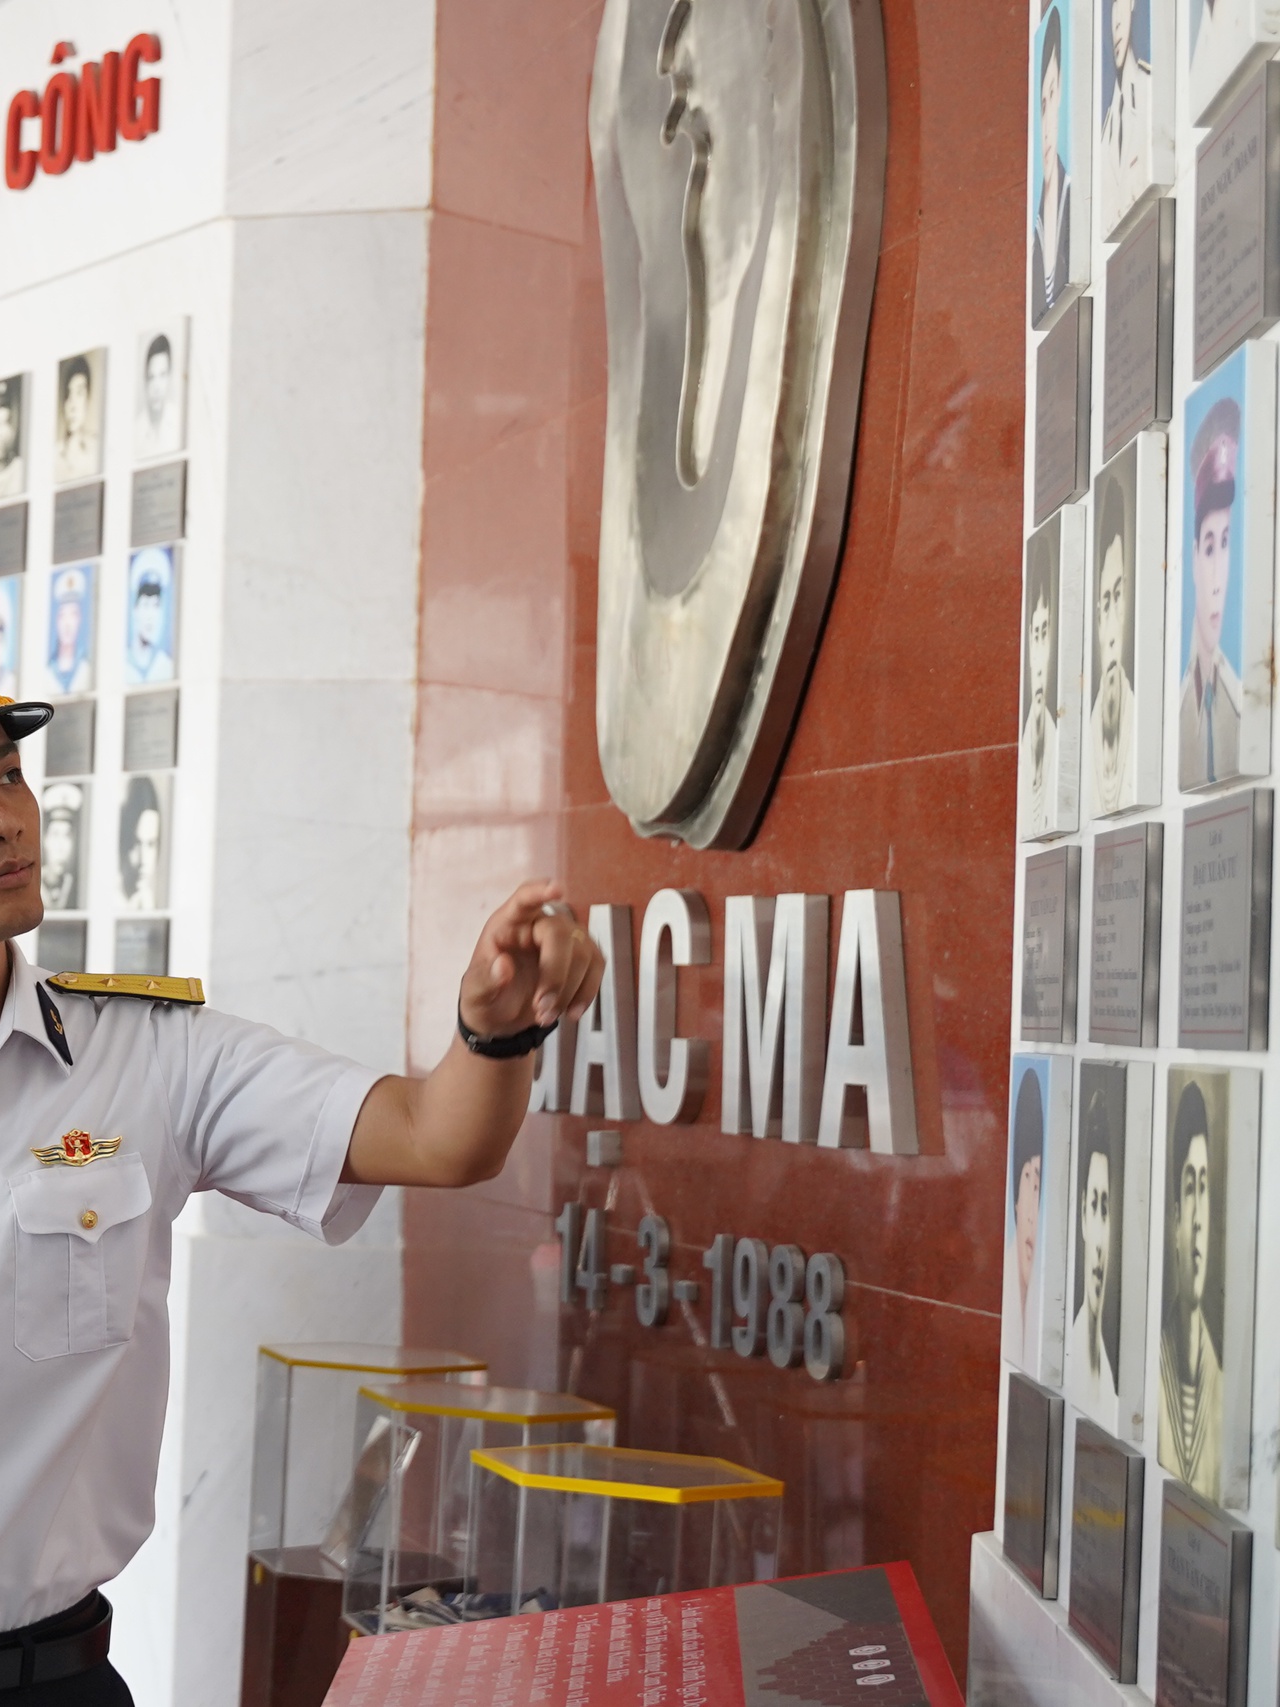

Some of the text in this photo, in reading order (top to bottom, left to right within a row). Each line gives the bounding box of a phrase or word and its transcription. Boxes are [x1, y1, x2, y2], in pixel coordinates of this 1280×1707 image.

[5, 33, 161, 190] CÔNG
[528, 888, 711, 1166] ẠC
[721, 888, 920, 1155] MA
[555, 1202, 846, 1380] 14-3-1988
[611, 1612, 633, 1625] Cam
[607, 1650, 630, 1670] Khánh
[644, 1671, 668, 1687] Cam
[676, 1680, 706, 1698] Ngọc
